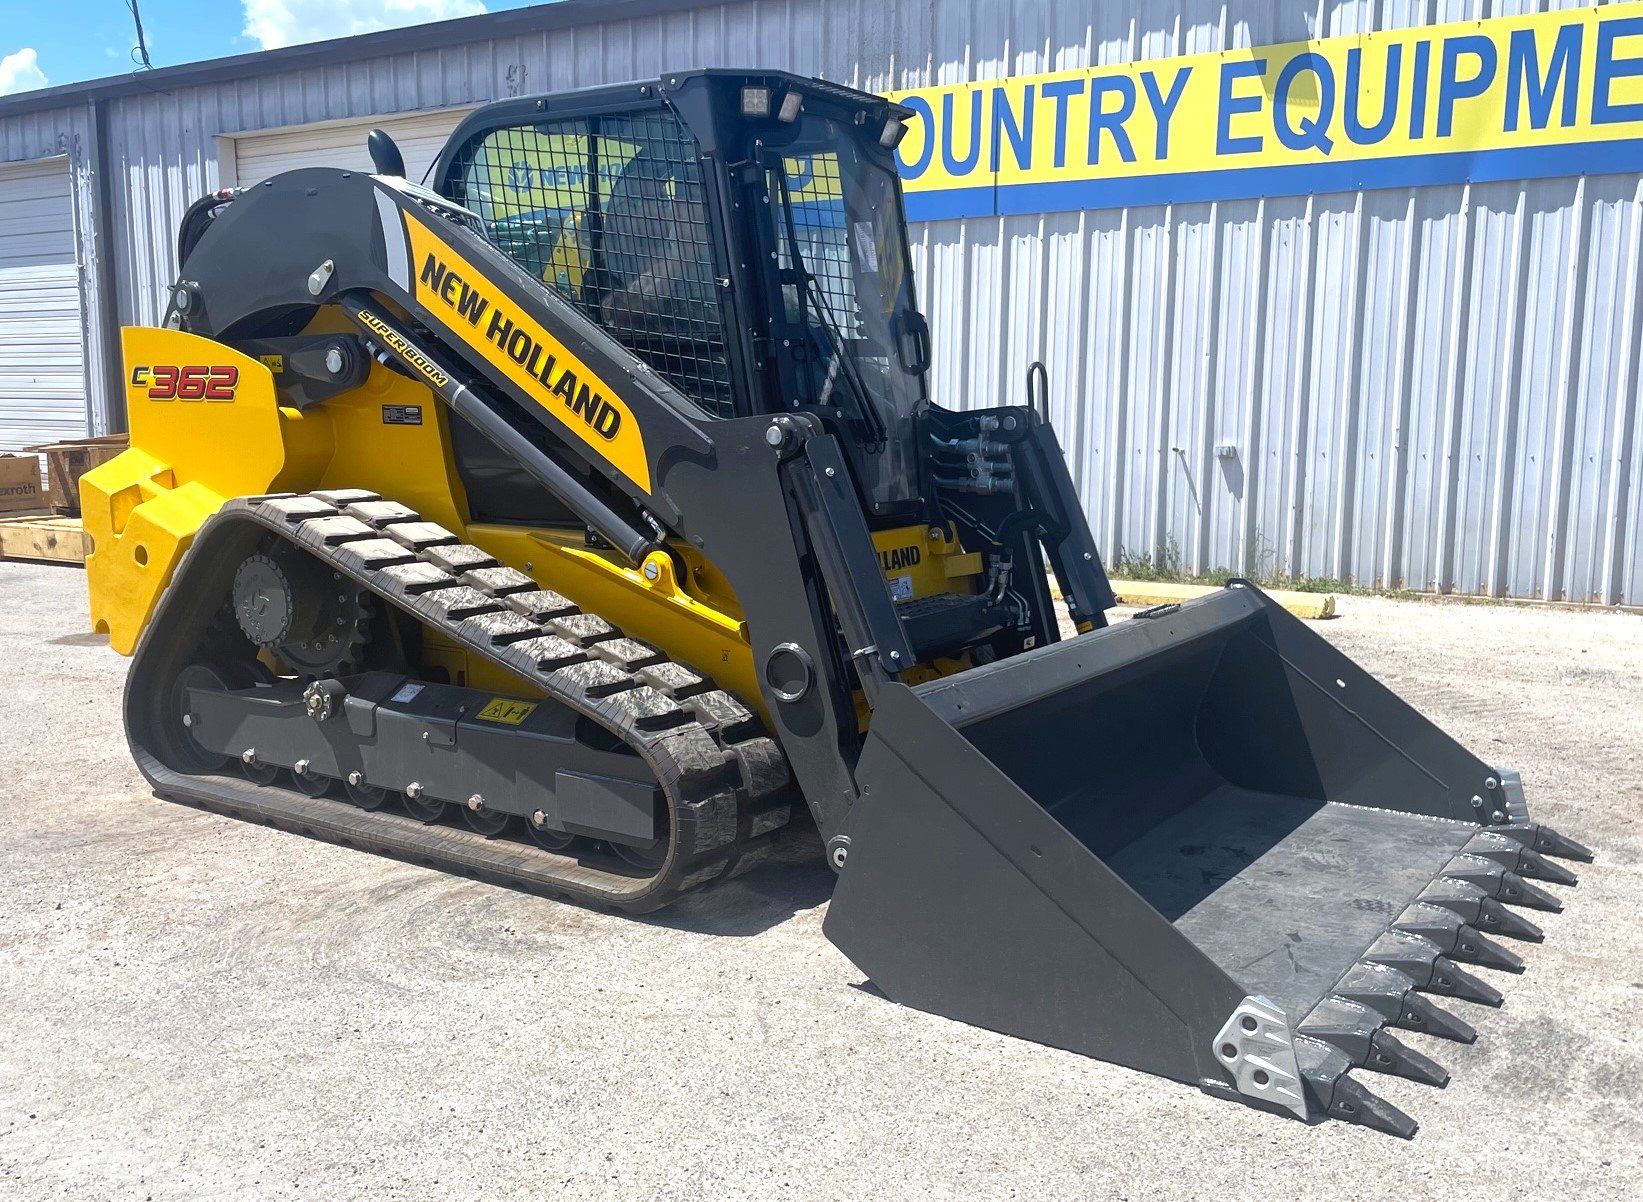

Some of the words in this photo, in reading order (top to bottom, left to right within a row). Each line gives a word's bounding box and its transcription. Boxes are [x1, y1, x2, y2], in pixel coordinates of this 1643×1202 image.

[540, 164, 587, 187] NEW
[359, 310, 407, 352] SUPER
[403, 347, 449, 387] BOOM
[420, 252, 489, 328] NEW
[485, 308, 622, 440] HOLLAND
